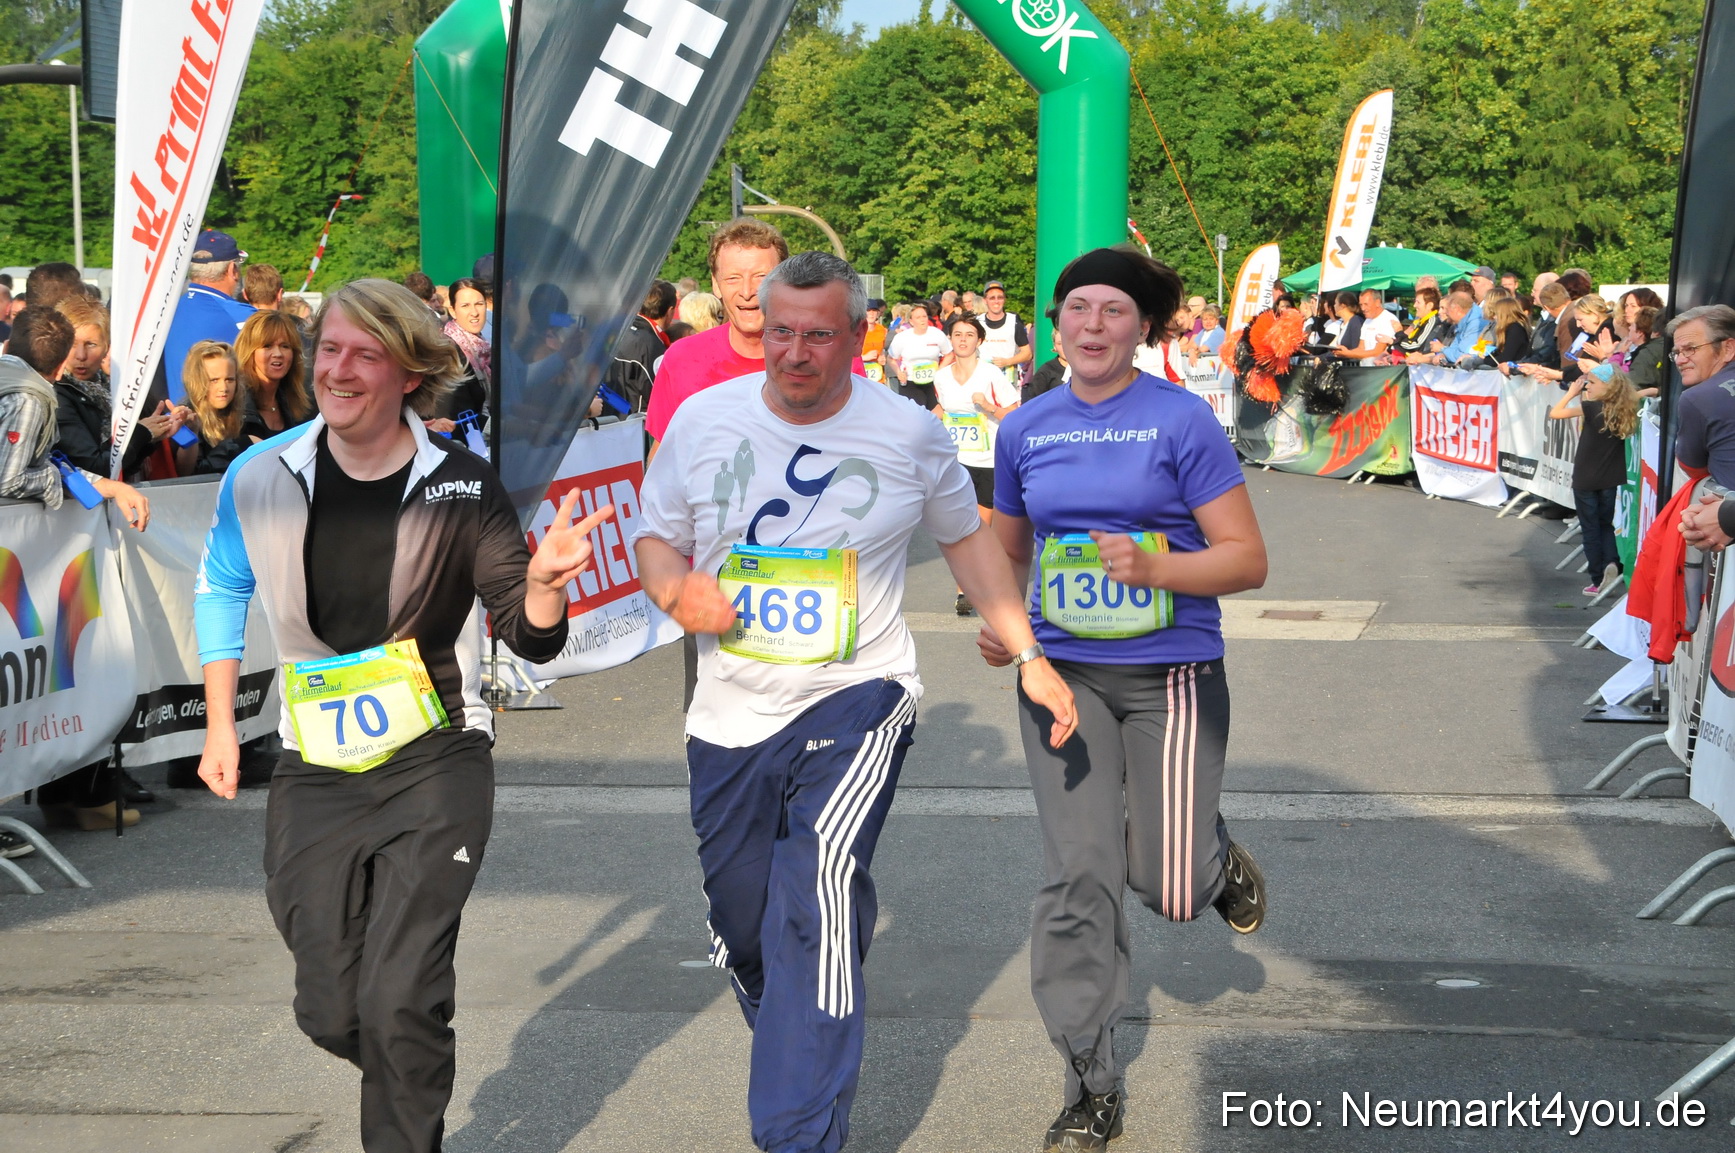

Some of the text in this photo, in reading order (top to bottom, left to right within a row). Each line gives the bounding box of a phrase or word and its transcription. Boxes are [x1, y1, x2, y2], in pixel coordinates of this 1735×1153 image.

[1340, 113, 1378, 228] KLEBL
[1365, 126, 1390, 205] www.klebl.de
[915, 369, 933, 379] 632
[1027, 428, 1158, 449] TEPPICHLÄUFER
[1420, 394, 1493, 466] MEIER
[424, 480, 482, 500] LUPINE
[731, 566, 776, 580] firmenlauf
[1048, 572, 1153, 609] 1306
[732, 584, 823, 635] 468
[1061, 613, 1113, 624] Stephanie
[736, 630, 785, 646] Bernhard
[302, 681, 342, 697] firmenlauf
[181, 698, 206, 717] die
[319, 694, 389, 746] 70
[337, 742, 374, 759] Stefan
